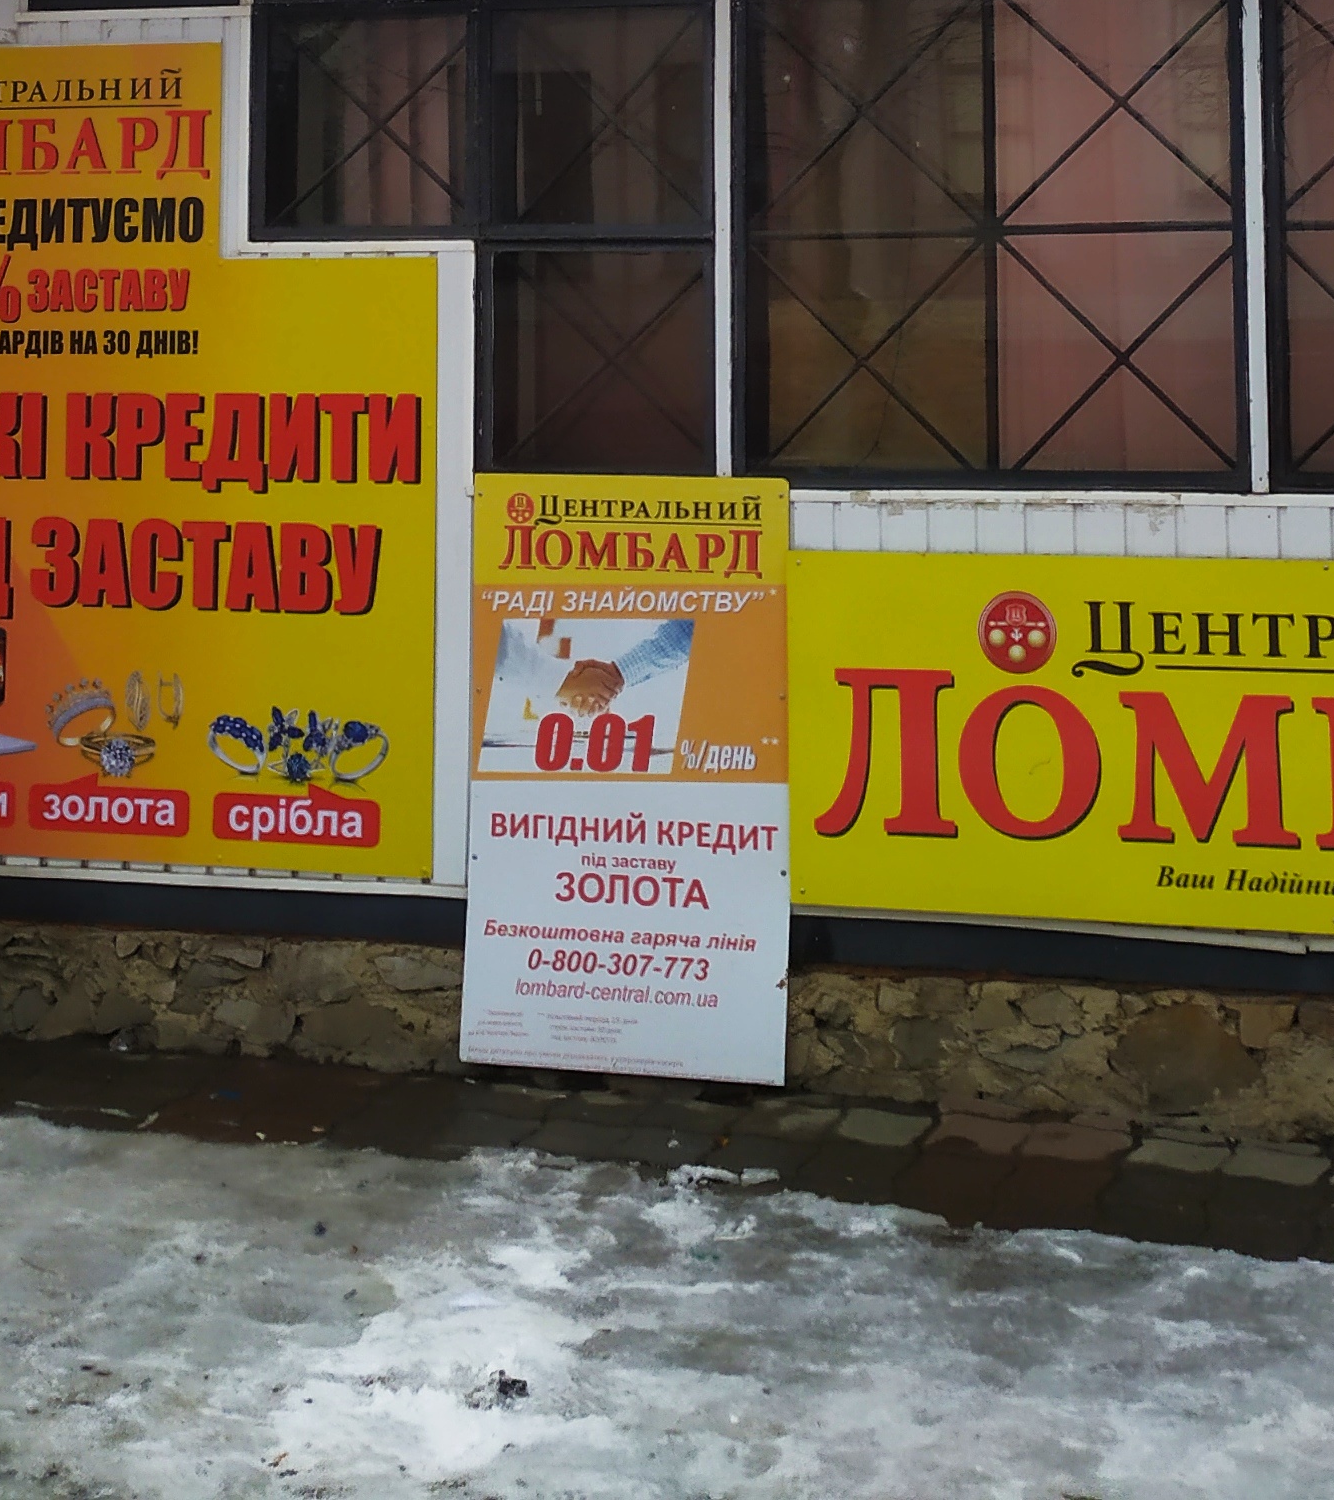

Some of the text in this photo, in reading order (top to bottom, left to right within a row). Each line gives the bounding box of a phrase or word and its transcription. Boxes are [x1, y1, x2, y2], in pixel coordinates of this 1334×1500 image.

[27, 268, 190, 314] ЗАСТАВУ
[70, 330, 98, 354] НА
[103, 330, 131, 354] 30
[136, 330, 199, 358] ДНІВ!
[66, 392, 422, 494] КРЕДИТИ
[534, 495, 762, 525] ЦЕНТРАЛЬНИЙ
[30, 516, 383, 616] ЗАСТАВУ
[498, 525, 763, 579] ЛОМБАРД
[534, 712, 657, 772] 0.01
[41, 792, 176, 827] золота
[228, 796, 364, 841] срібла
[490, 812, 779, 855] ВИГІДНИЙ КРЕДИТ
[580, 854, 677, 874] під заставу
[1156, 865, 1215, 890] Ваш
[555, 872, 710, 910] ЗОЛОТА
[484, 920, 757, 952] Безкоштовна гаряча лінія
[528, 949, 710, 981] 0-800-307-773
[516, 978, 719, 1008] lombard-central.com.ua
